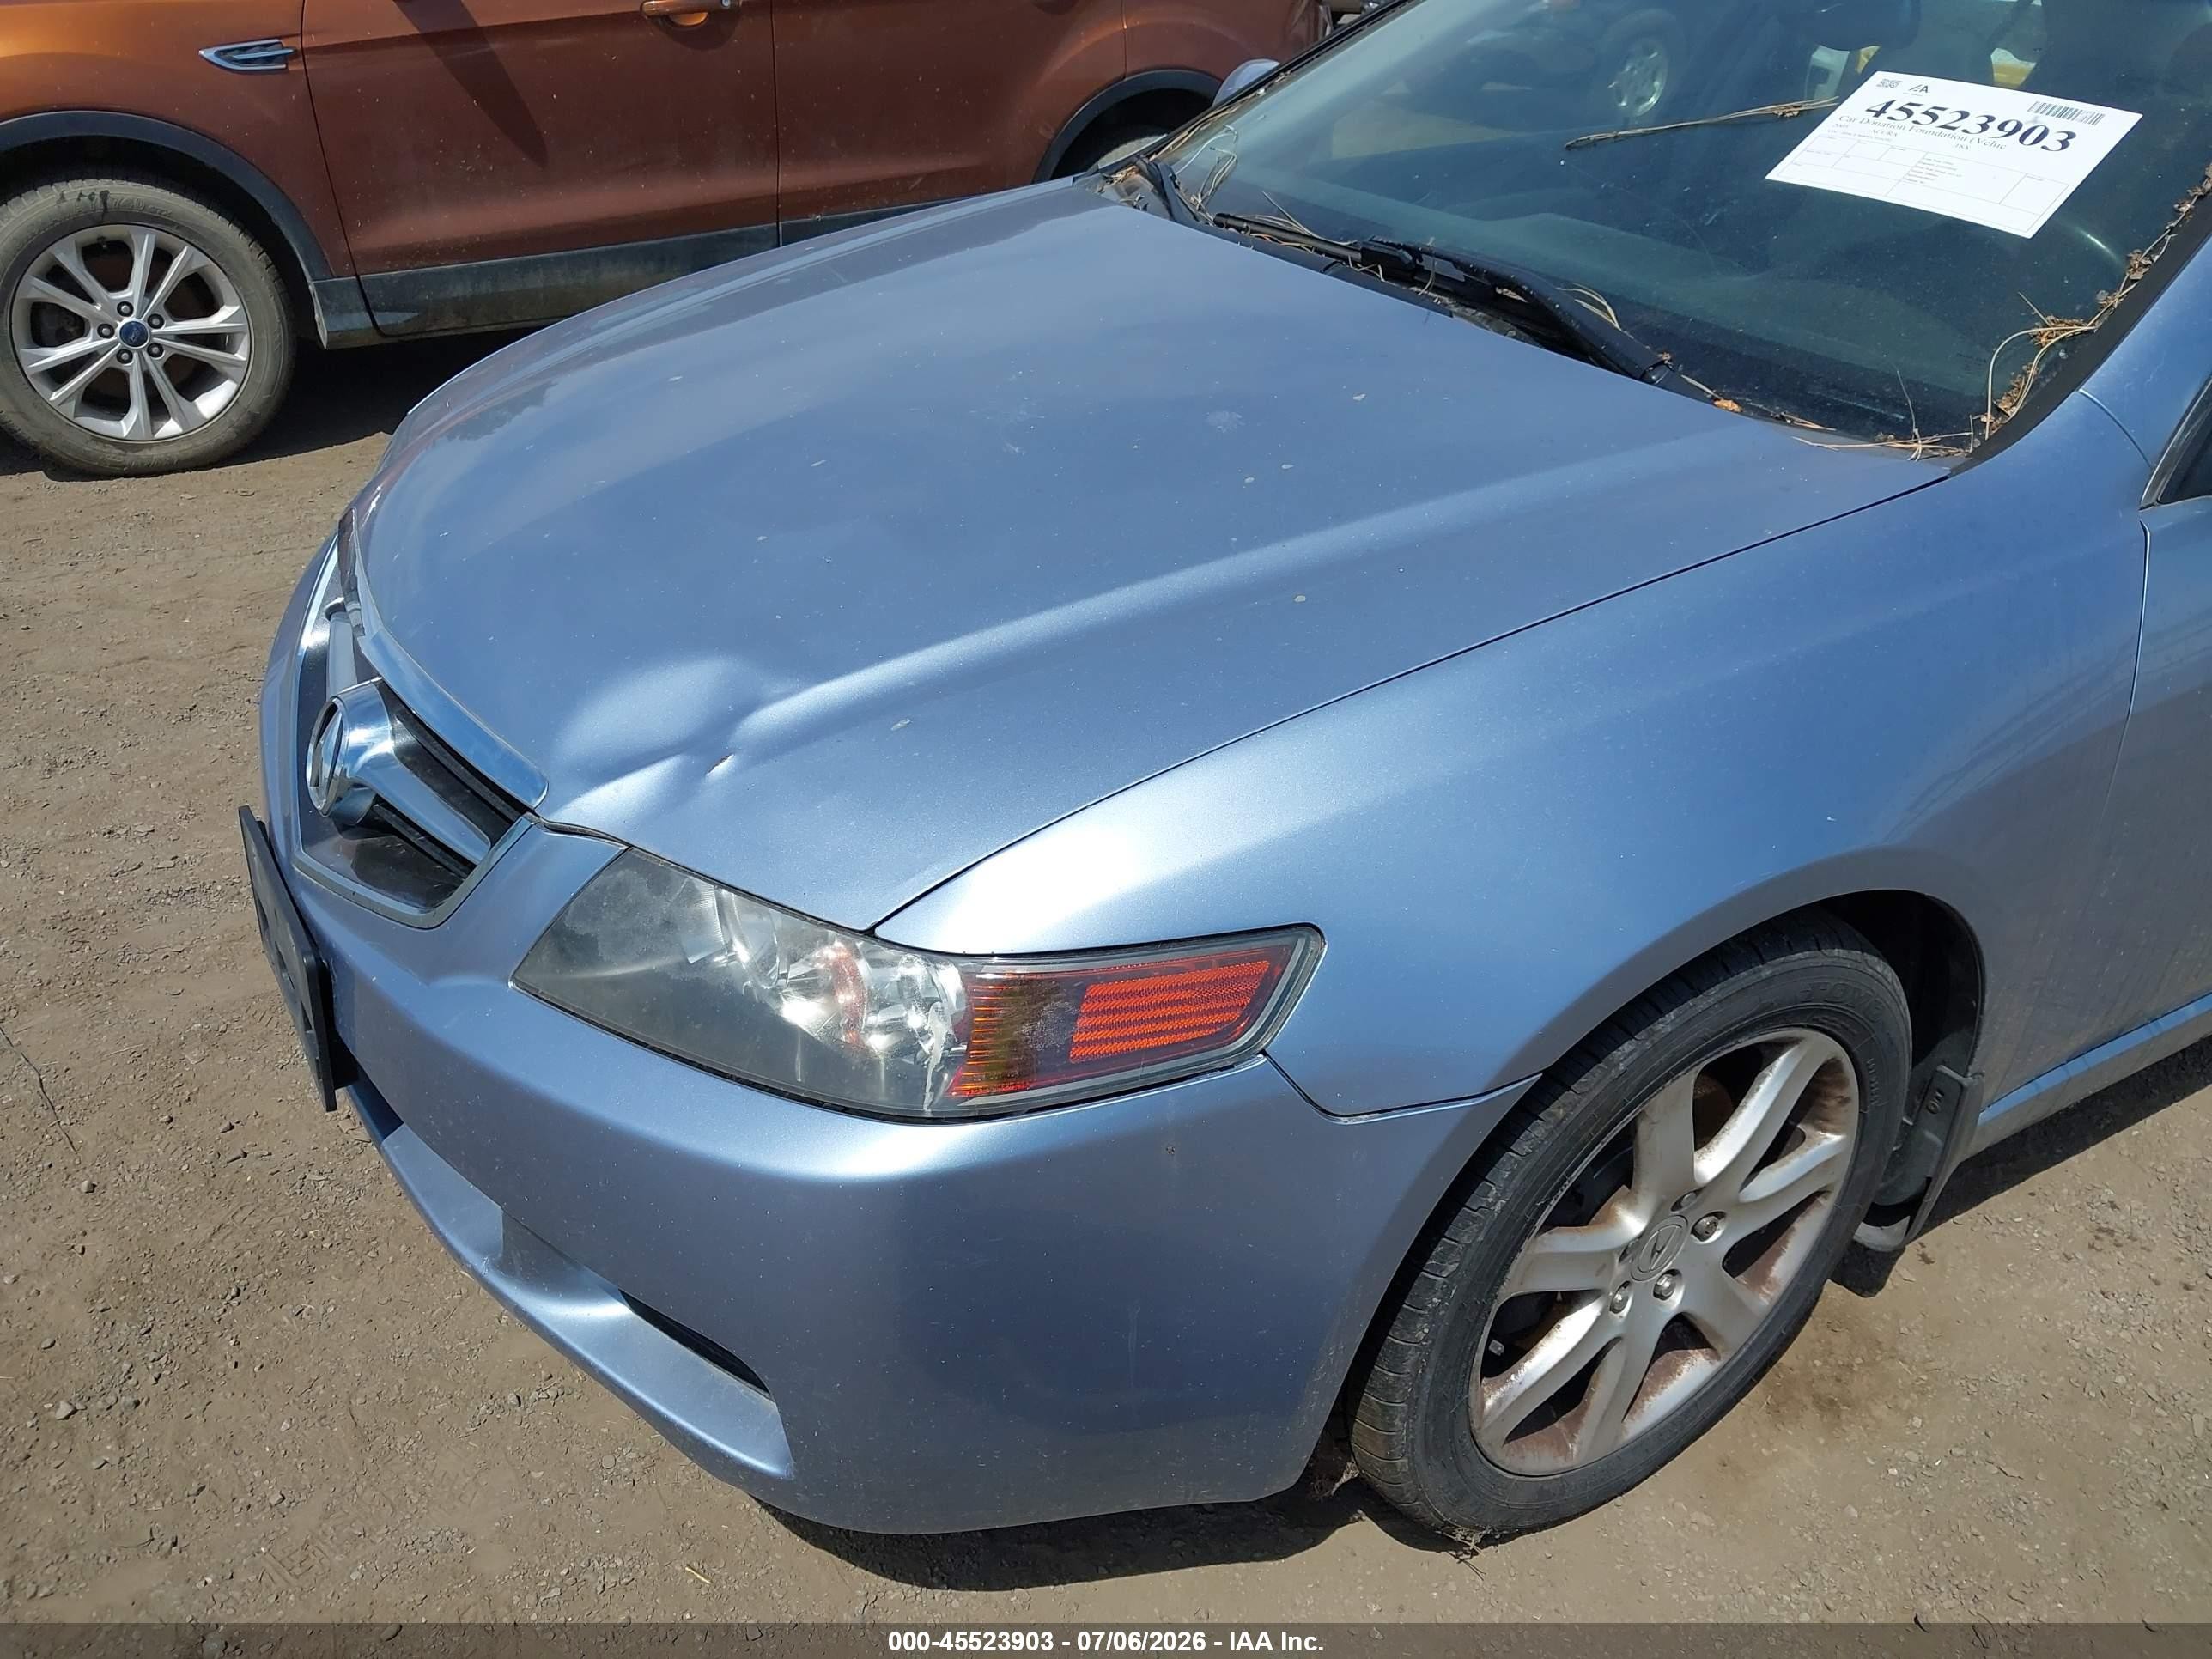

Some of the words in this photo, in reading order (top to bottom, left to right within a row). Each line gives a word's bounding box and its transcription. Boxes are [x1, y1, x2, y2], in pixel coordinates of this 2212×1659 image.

[1838, 114, 1857, 125] Car
[1859, 117, 1906, 131] Donation
[1908, 125, 1972, 143] Foundation
[1865, 99, 2077, 153] 45523903
